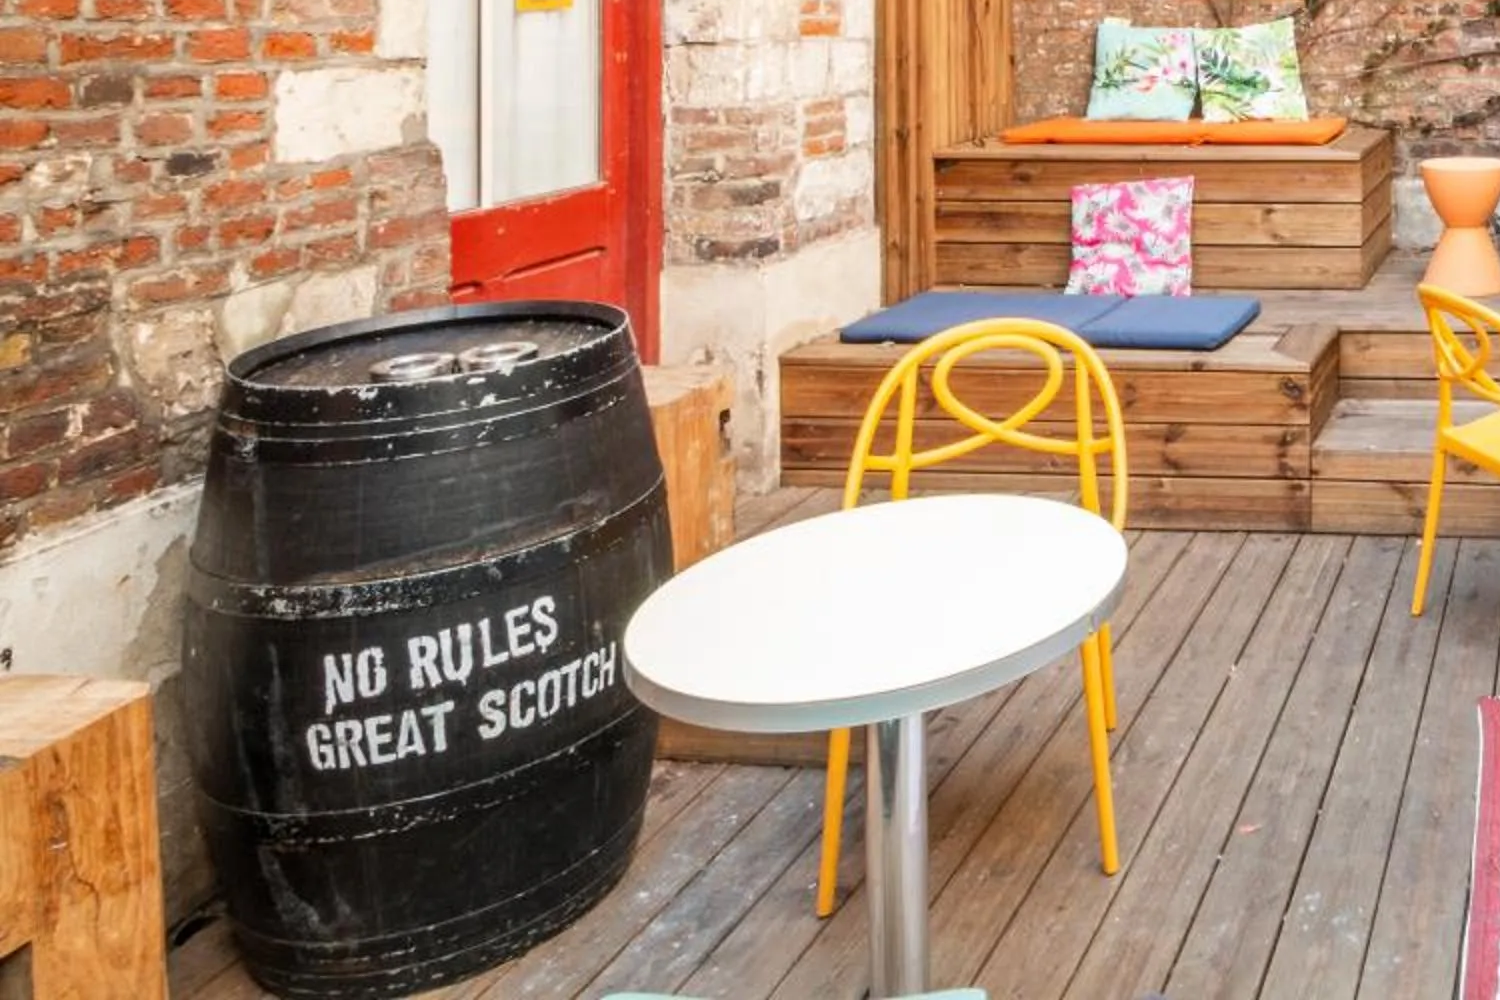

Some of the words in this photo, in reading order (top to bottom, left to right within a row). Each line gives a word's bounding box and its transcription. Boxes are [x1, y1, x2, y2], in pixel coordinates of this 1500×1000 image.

[306, 700, 455, 771] GREAT
[478, 640, 617, 740] SCOTCH
[323, 646, 388, 715] NO
[408, 596, 559, 690] RULES
